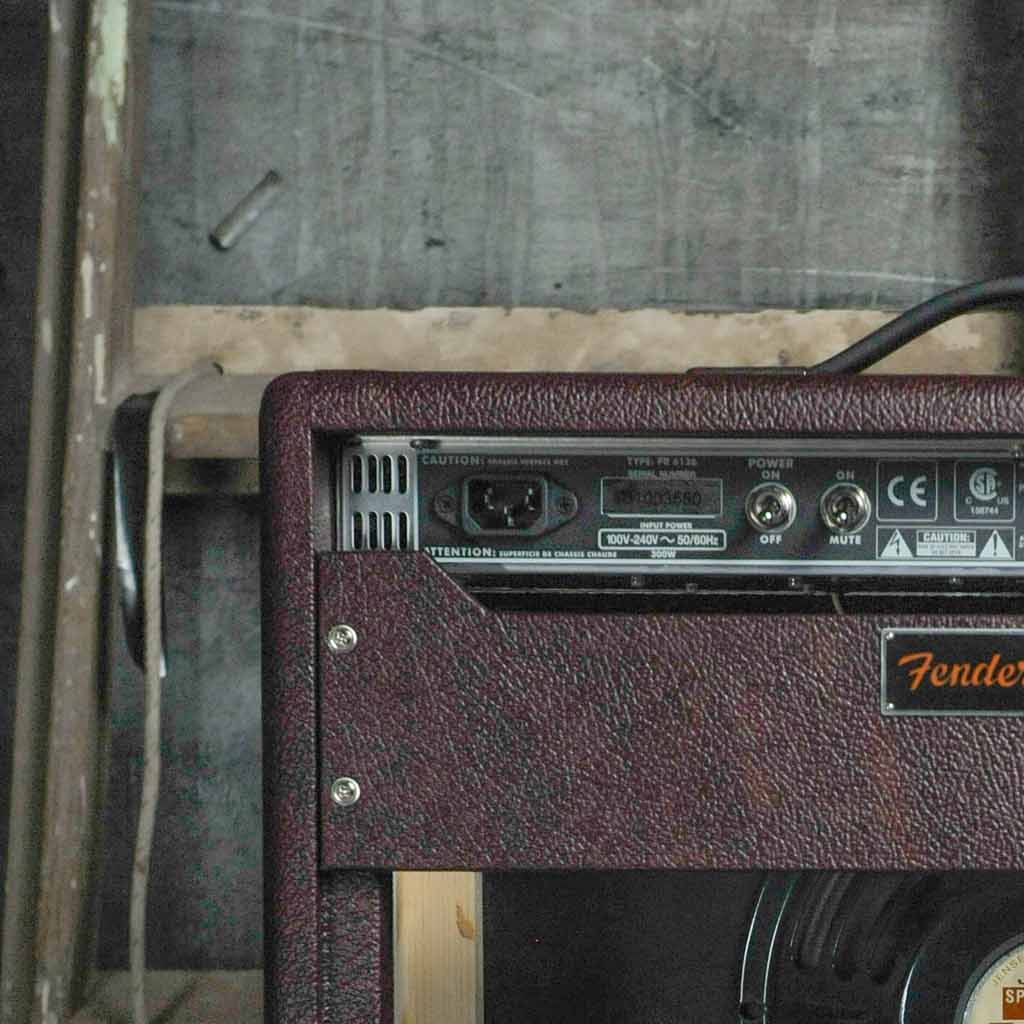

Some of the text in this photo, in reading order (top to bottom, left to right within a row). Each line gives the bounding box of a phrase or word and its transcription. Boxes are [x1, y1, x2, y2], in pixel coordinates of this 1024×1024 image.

[422, 455, 485, 466] CAUTION:
[747, 458, 794, 469] POWER
[761, 470, 855, 480] ON ON
[887, 475, 928, 507] CE
[640, 521, 693, 529] INPUT POWER
[607, 534, 658, 545] 100V-240V
[677, 534, 719, 545] 50/60Hz
[760, 534, 783, 545] OFF
[829, 535, 862, 545] MUTE
[923, 532, 971, 542] CAUTION:
